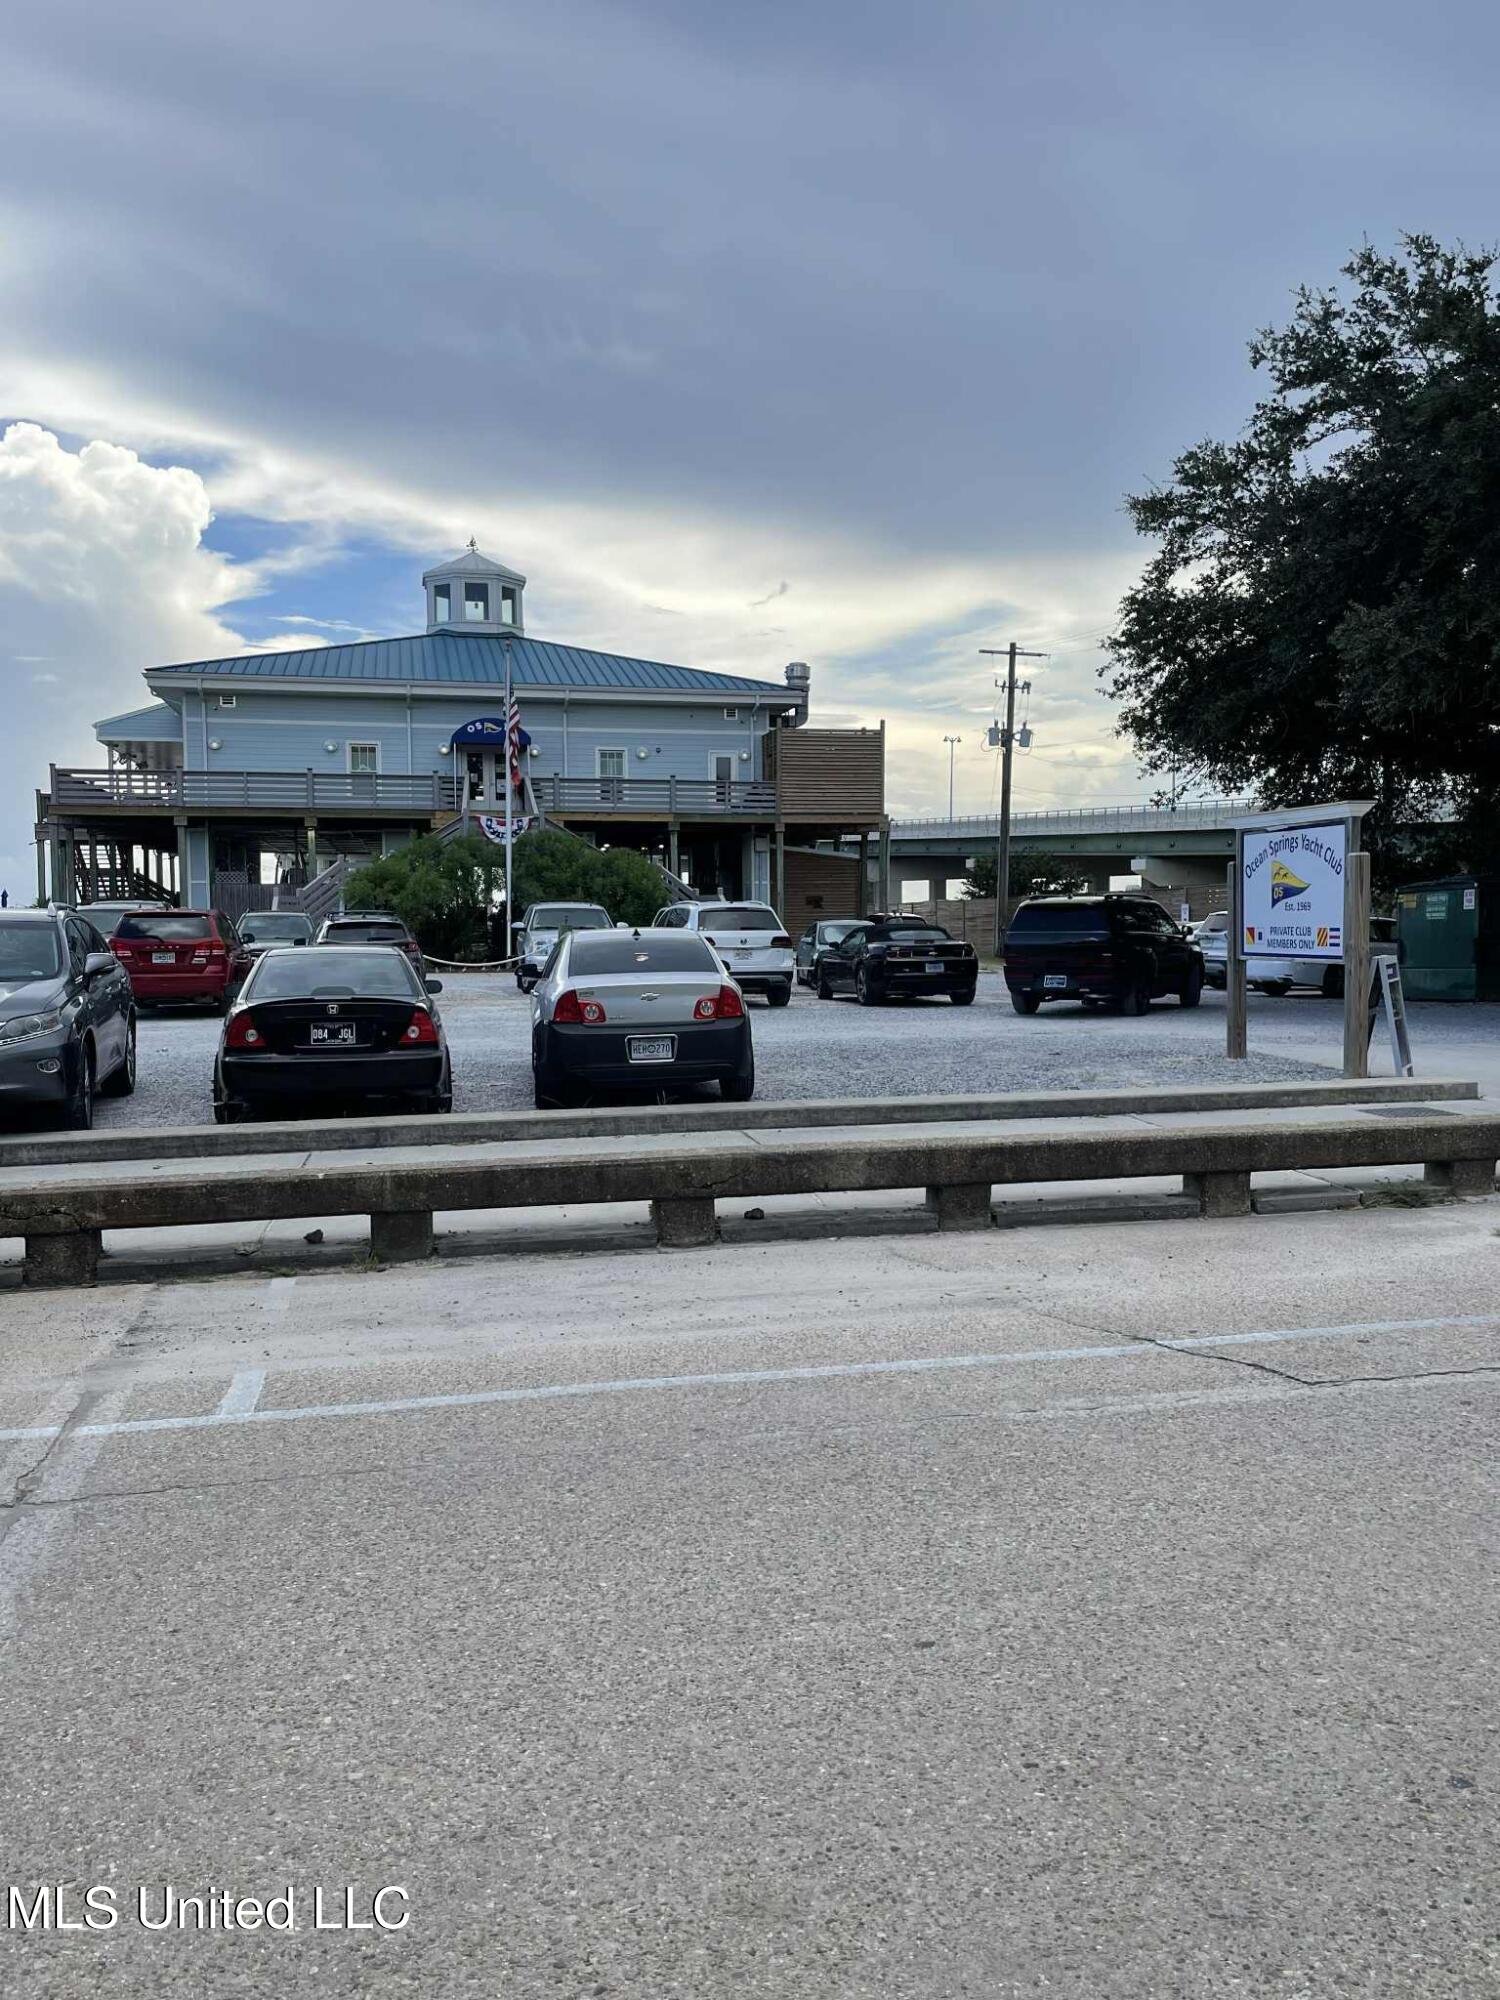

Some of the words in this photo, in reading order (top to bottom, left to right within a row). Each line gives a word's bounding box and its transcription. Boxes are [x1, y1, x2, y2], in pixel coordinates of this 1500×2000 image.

[466, 722, 482, 733] OS
[1245, 849, 1268, 879] Ocean
[1269, 835, 1299, 857] Springs
[1301, 833, 1324, 858] Yacht
[1323, 847, 1343, 875] Club
[1273, 887, 1284, 899] OS
[1285, 902, 1296, 911] Est.
[1297, 902, 1312, 911] 1969
[1270, 926, 1295, 937] PRIVATE
[1296, 927, 1312, 936] CLUB
[1267, 939, 1298, 949] MEMBERS
[1298, 940, 1315, 949] ONLY
